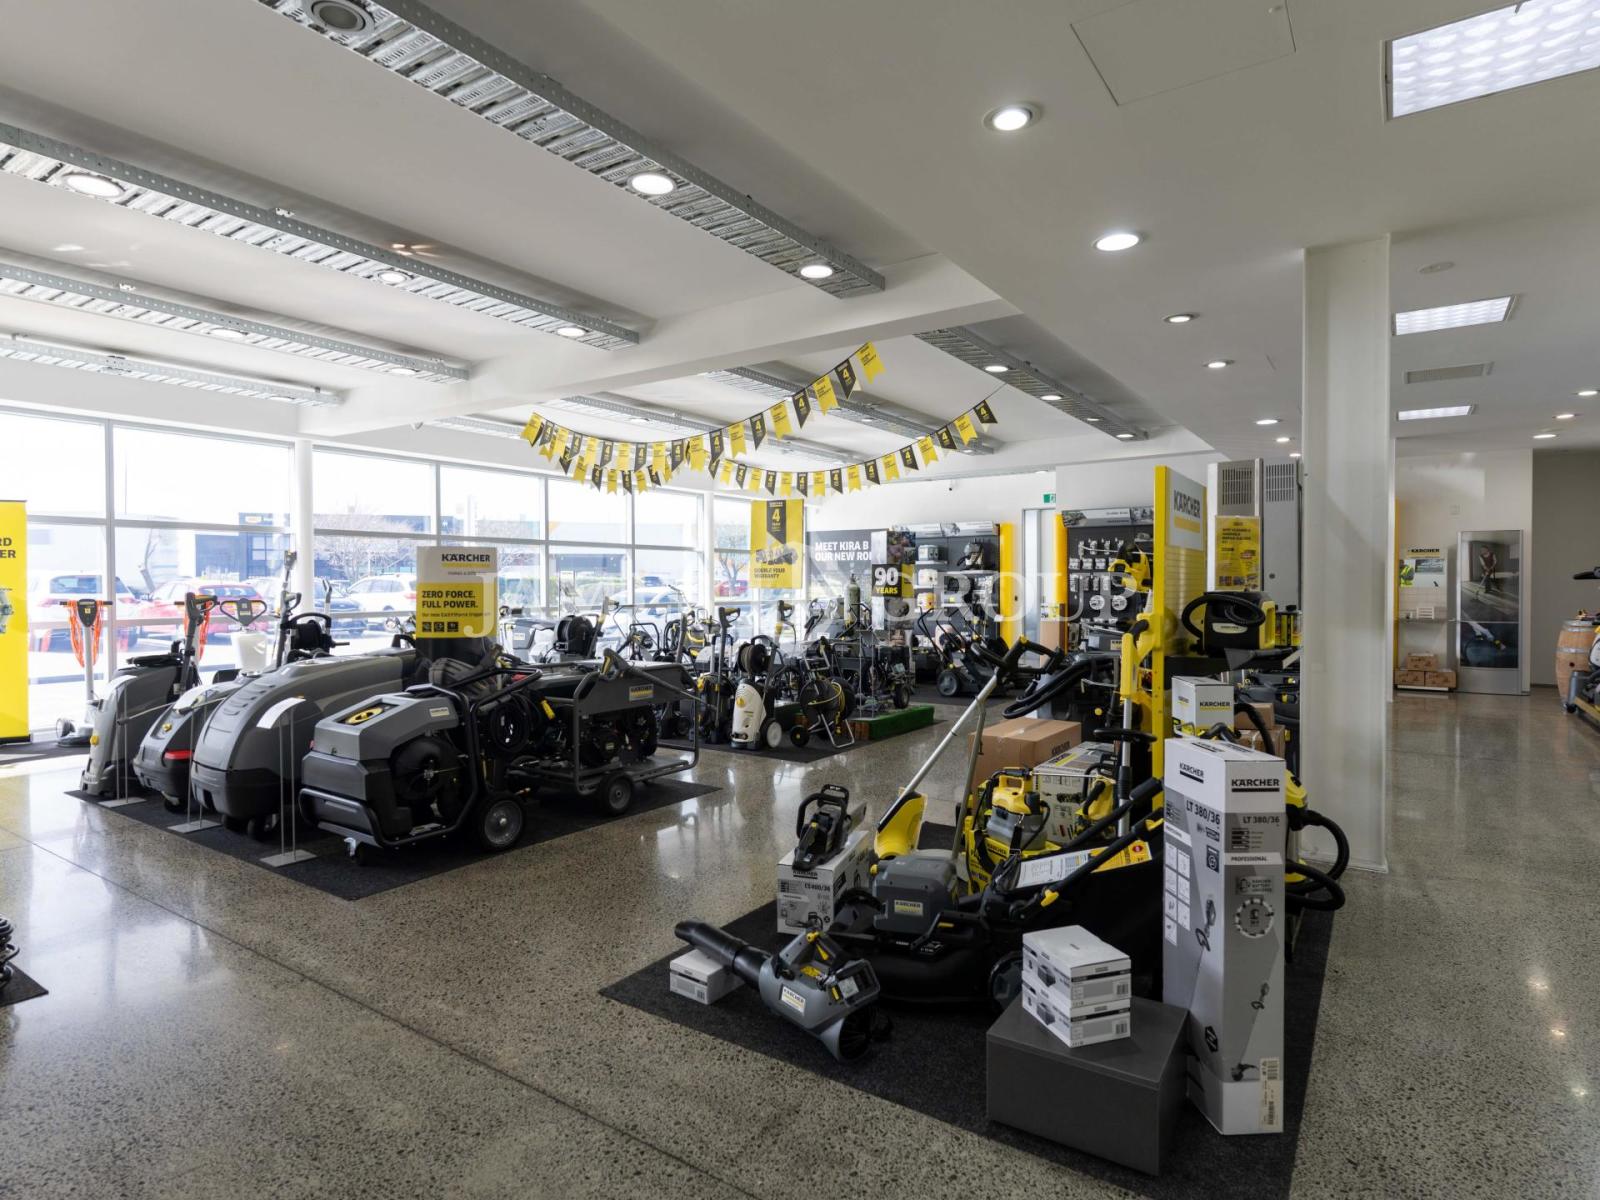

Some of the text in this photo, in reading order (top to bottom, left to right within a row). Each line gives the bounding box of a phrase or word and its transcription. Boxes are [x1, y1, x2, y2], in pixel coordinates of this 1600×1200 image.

[772, 508, 780, 521] 4
[0, 537, 12, 546] D
[815, 541, 838, 551] MEET
[839, 541, 861, 551] KIRA
[815, 551, 833, 561] OUR
[834, 551, 855, 561] NEW
[875, 567, 898, 586] 90
[445, 591, 475, 599] FORCE.
[876, 587, 898, 595] YEARS
[443, 601, 478, 609] POWER.
[1186, 800, 1194, 813] LT
[1194, 804, 1221, 825] 380/36
[1242, 815, 1280, 824] LT 380/36
